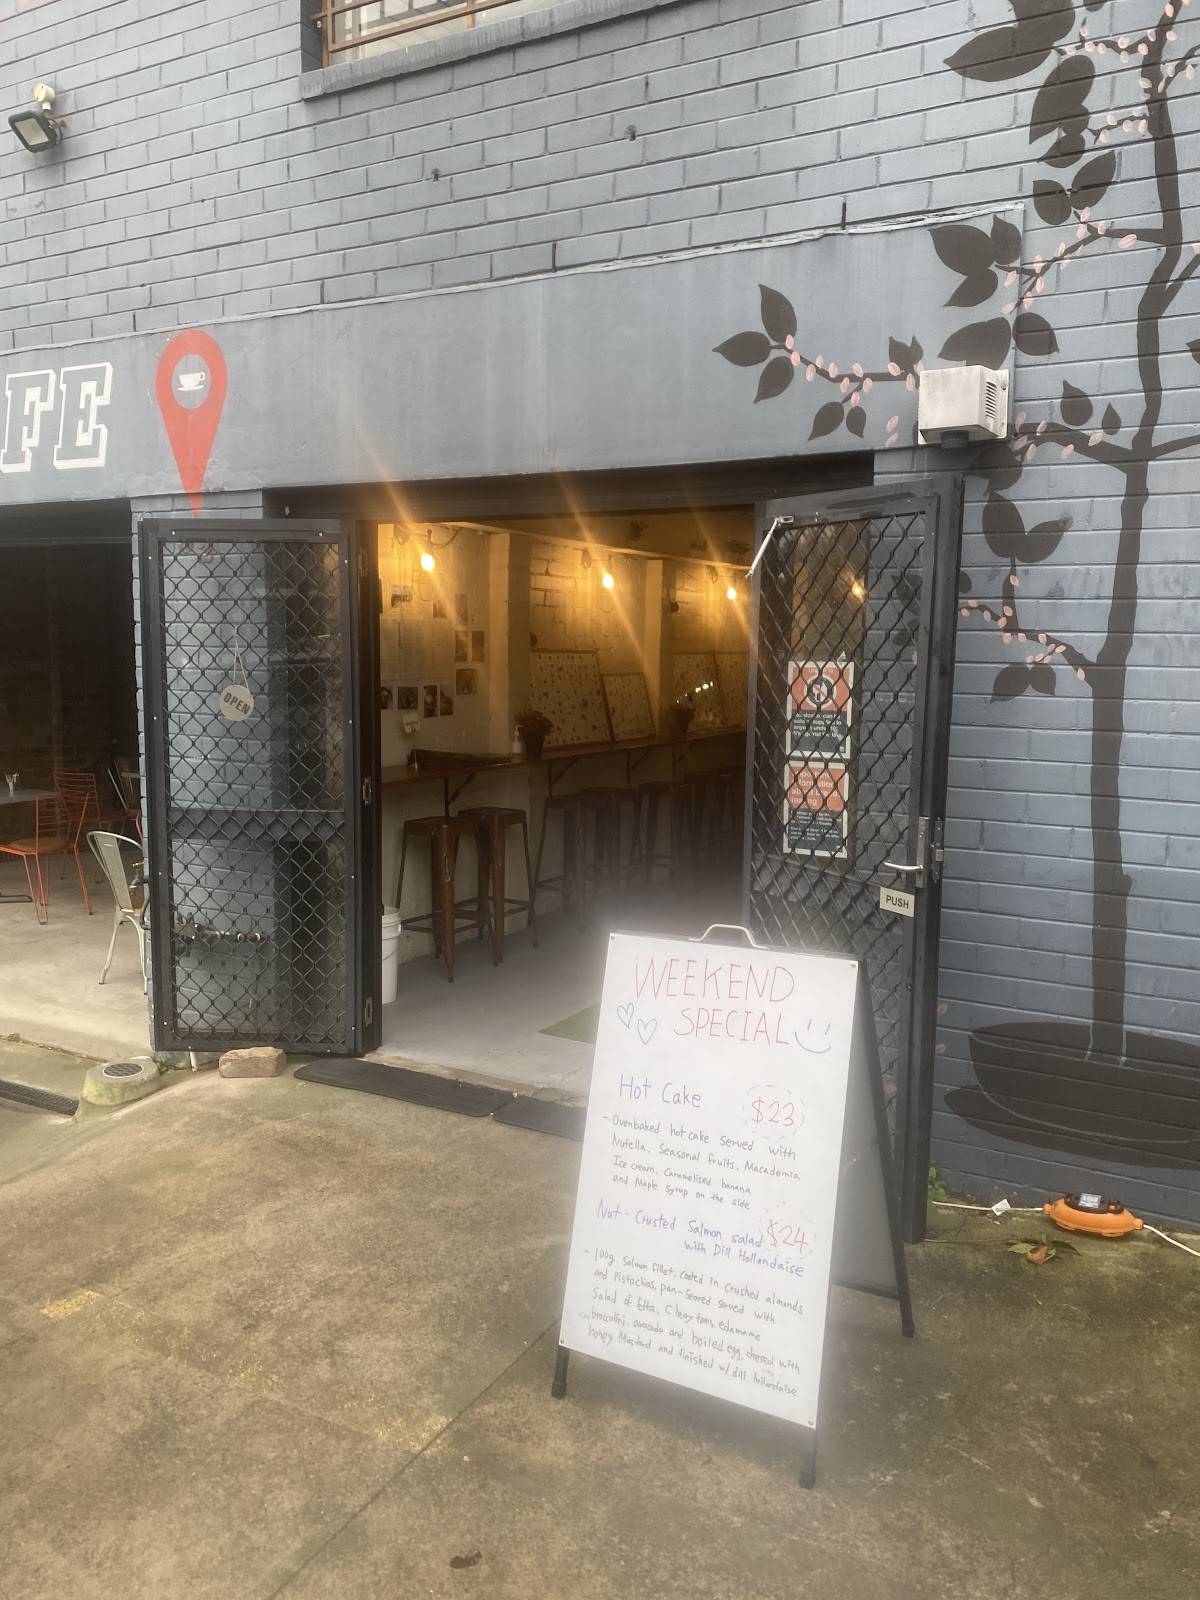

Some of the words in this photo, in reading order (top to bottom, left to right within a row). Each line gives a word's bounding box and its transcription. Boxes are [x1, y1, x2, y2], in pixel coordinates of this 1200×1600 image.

[223, 692, 250, 714] OPEN
[886, 894, 910, 909] PUSH
[635, 958, 795, 1002] WEEKEND
[674, 1007, 789, 1045] SPECIAL
[619, 1074, 652, 1100] Hot
[662, 1082, 702, 1108] Cake
[612, 1114, 660, 1134] Ovenbaked
[751, 1097, 795, 1126] $23
[696, 1191, 706, 1200] on
[711, 1192, 725, 1204] the
[767, 1220, 809, 1254] $24
[713, 1243, 731, 1259] Dill
[739, 1249, 805, 1278] Hollandaise
[709, 1276, 719, 1288] in
